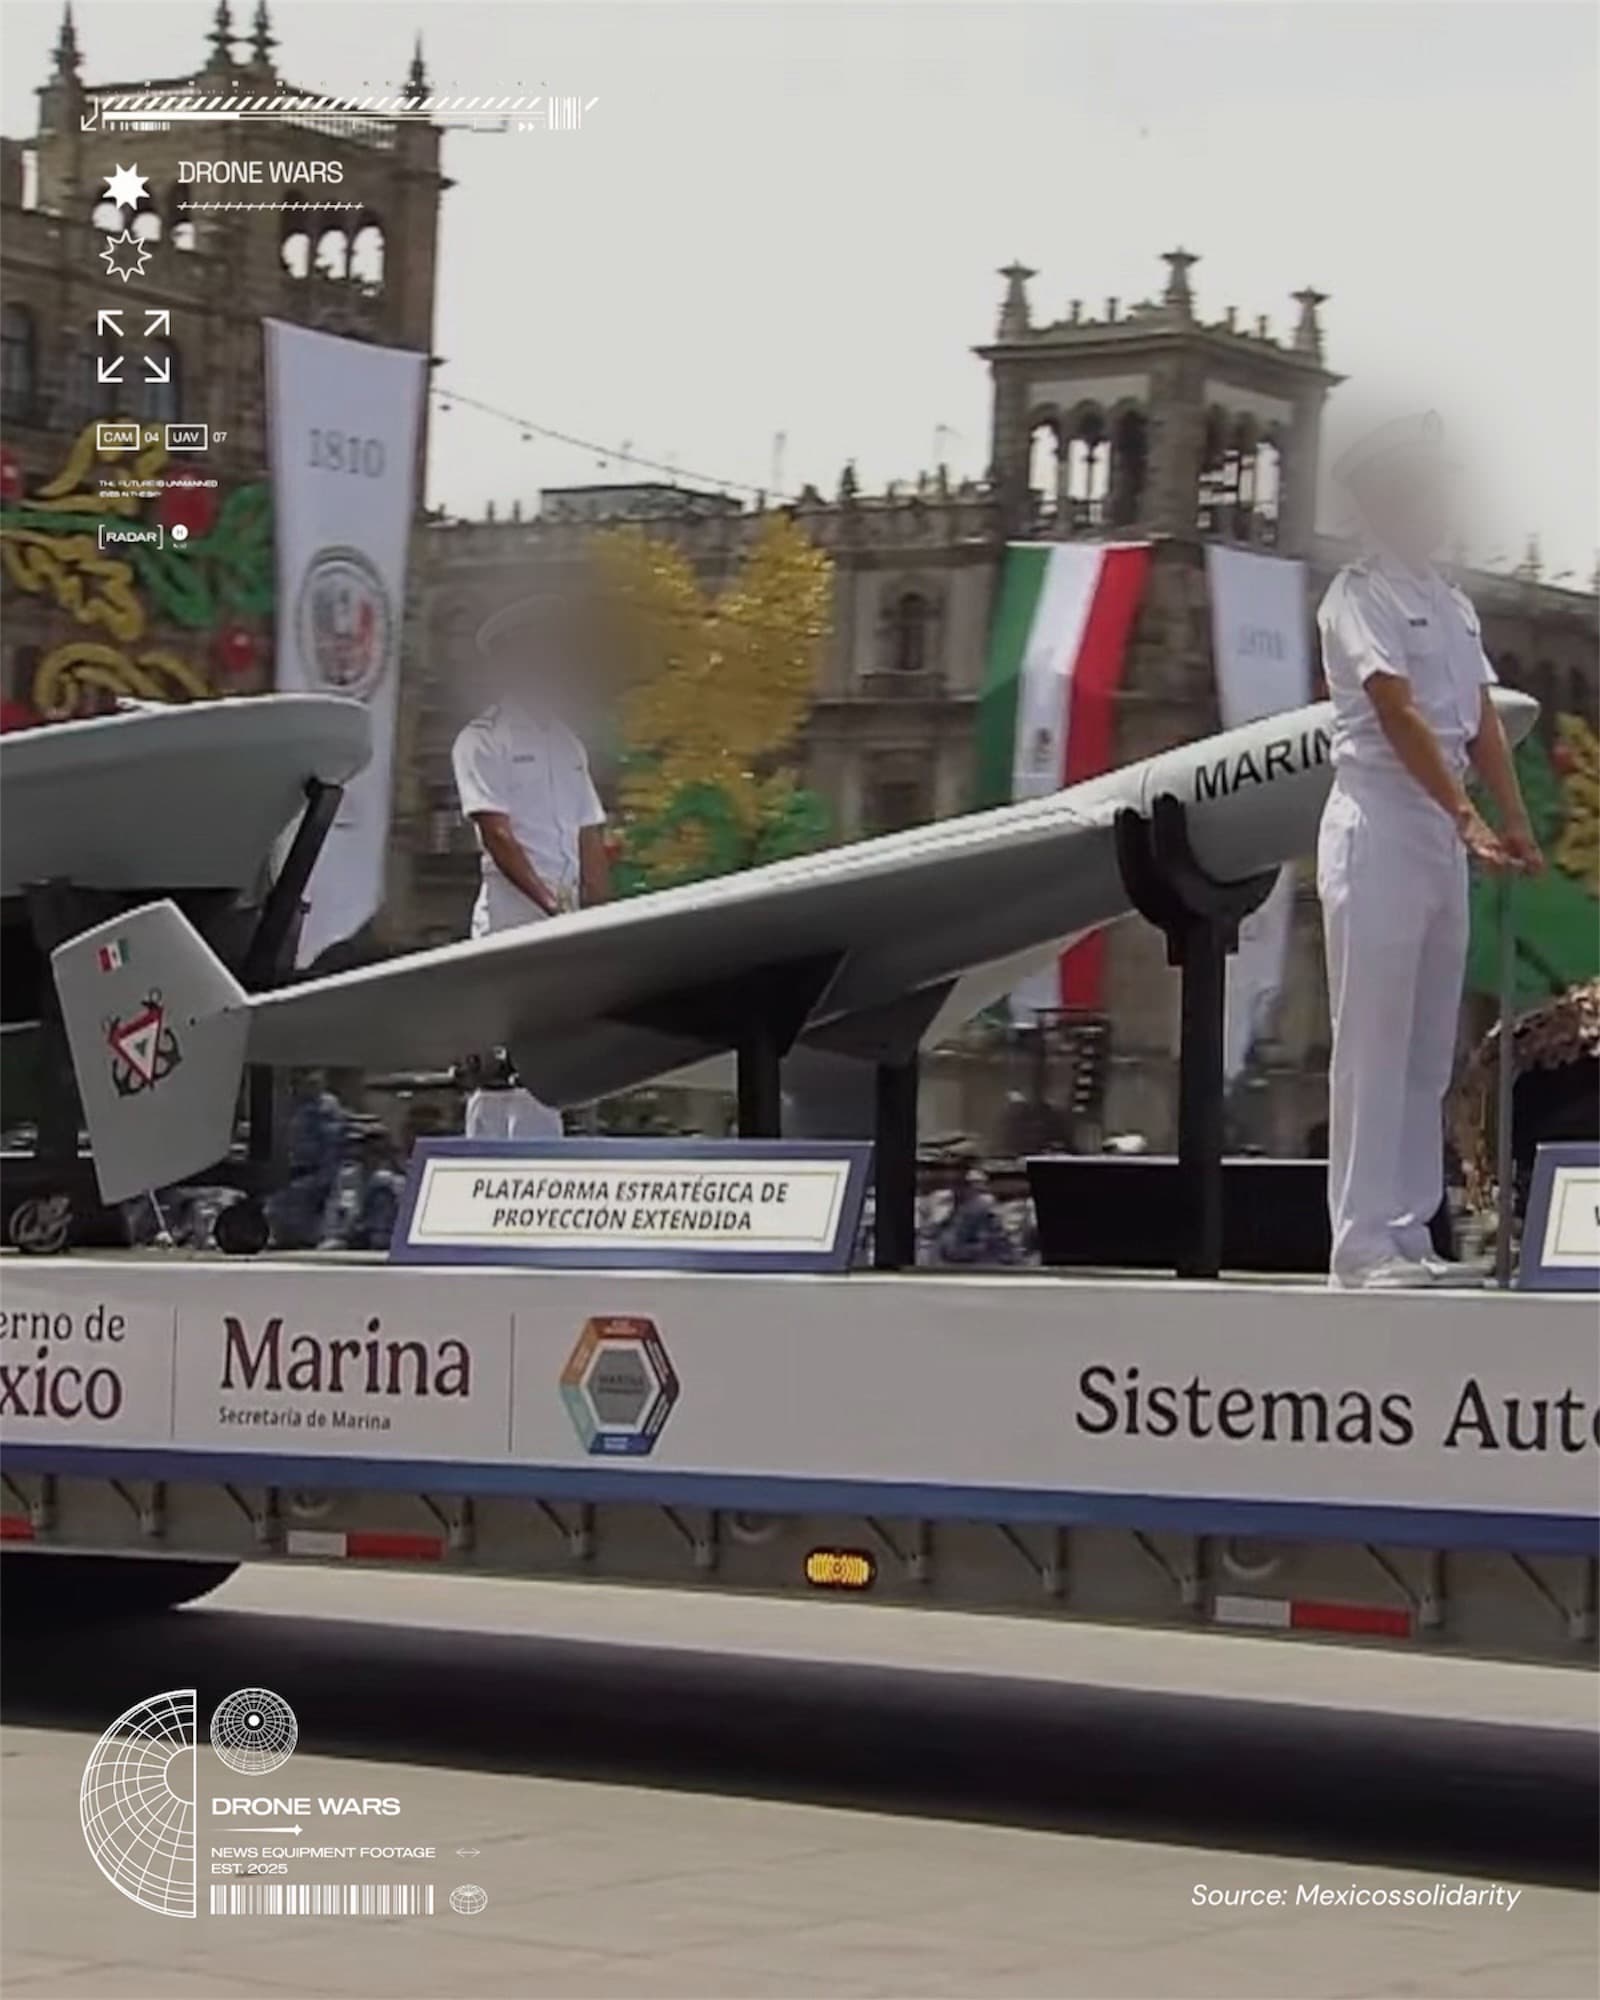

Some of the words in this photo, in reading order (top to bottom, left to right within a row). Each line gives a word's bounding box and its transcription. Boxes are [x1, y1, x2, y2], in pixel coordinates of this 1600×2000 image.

[308, 428, 386, 478] 1810
[472, 1178, 609, 1200] PLATAFORMA
[616, 1174, 754, 1203] ESTRATÉGICA
[760, 1182, 789, 1204] DE
[492, 1205, 627, 1230] PROYECCIÓN
[631, 1209, 752, 1231] EXTENDIDA
[85, 1304, 126, 1342] de
[220, 1317, 471, 1398] Marina
[0, 1346, 122, 1420] xico
[1076, 1363, 1415, 1447] Sistemas
[219, 1405, 302, 1427] Secretaría
[306, 1409, 327, 1428] de
[332, 1410, 391, 1430] Marina
